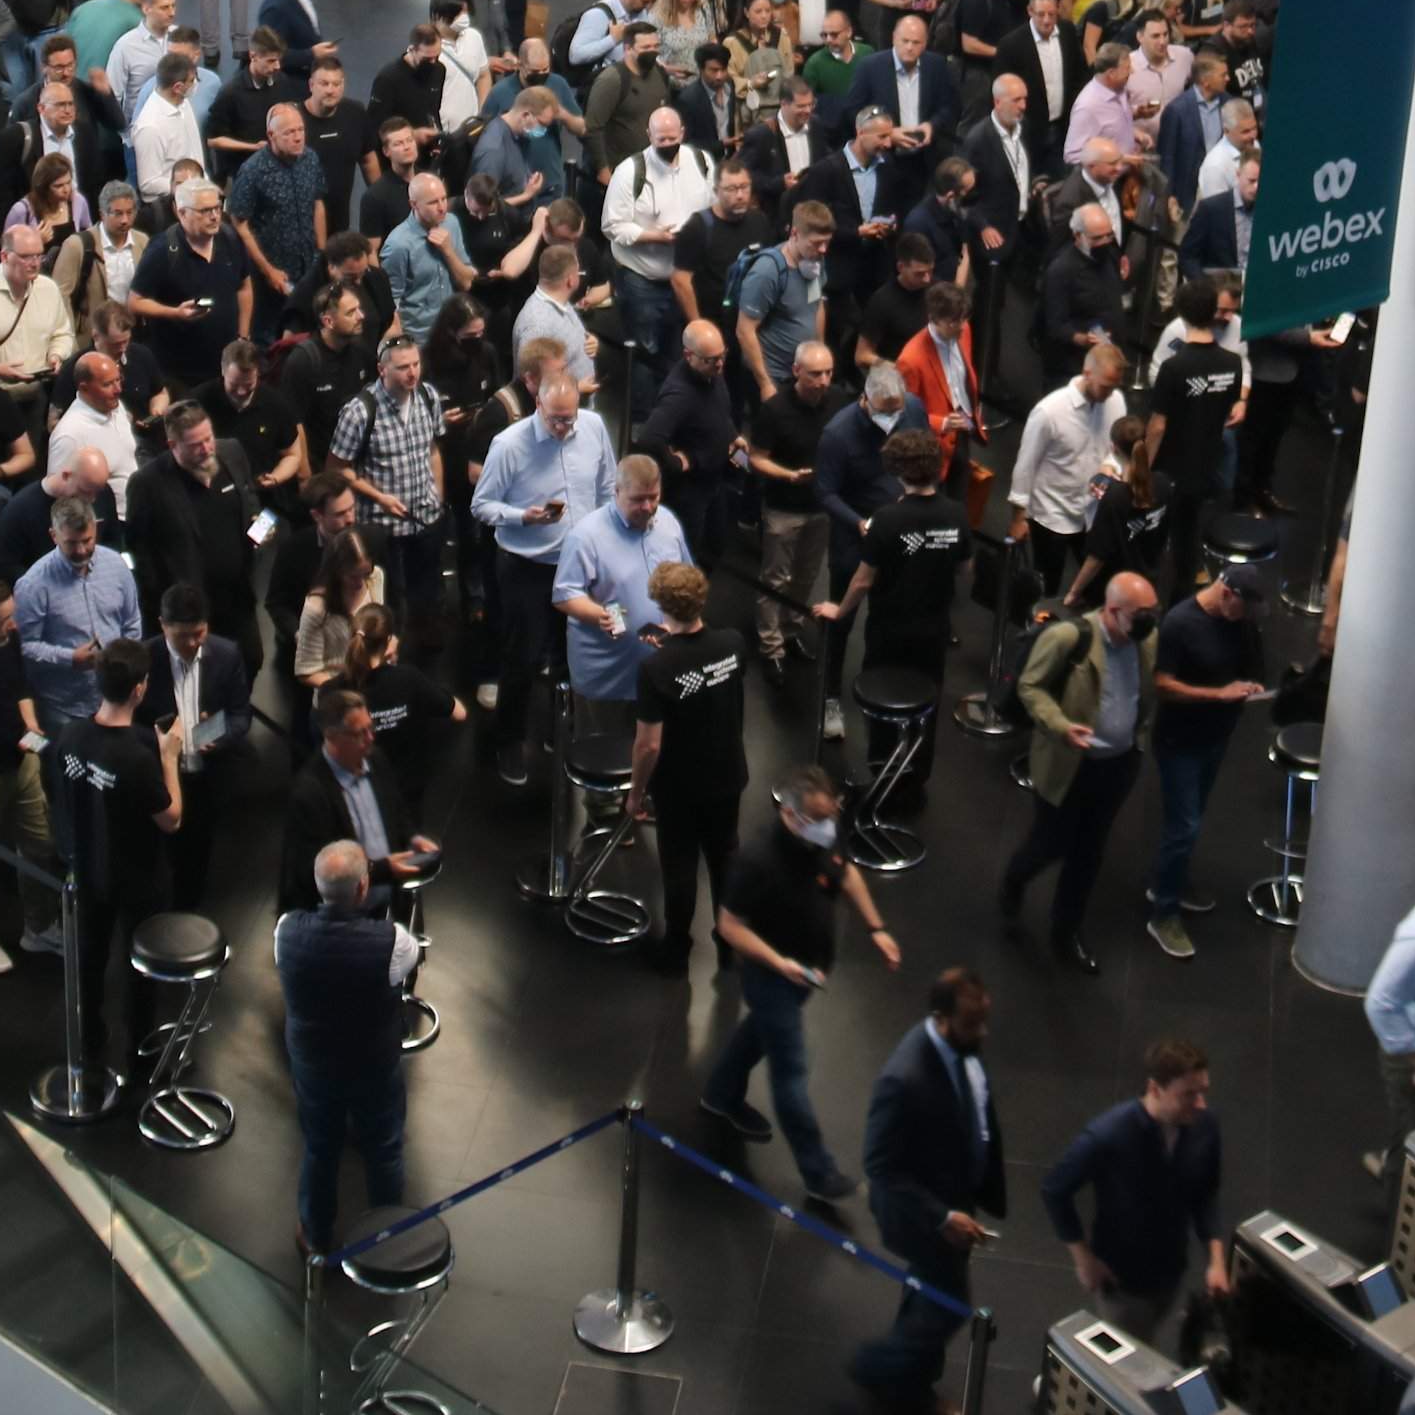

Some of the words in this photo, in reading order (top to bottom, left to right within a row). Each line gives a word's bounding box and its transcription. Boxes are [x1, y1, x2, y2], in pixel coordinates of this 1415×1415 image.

[1267, 207, 1387, 263] webex
[1295, 263, 1310, 279] by
[1310, 251, 1351, 274] CISCO
